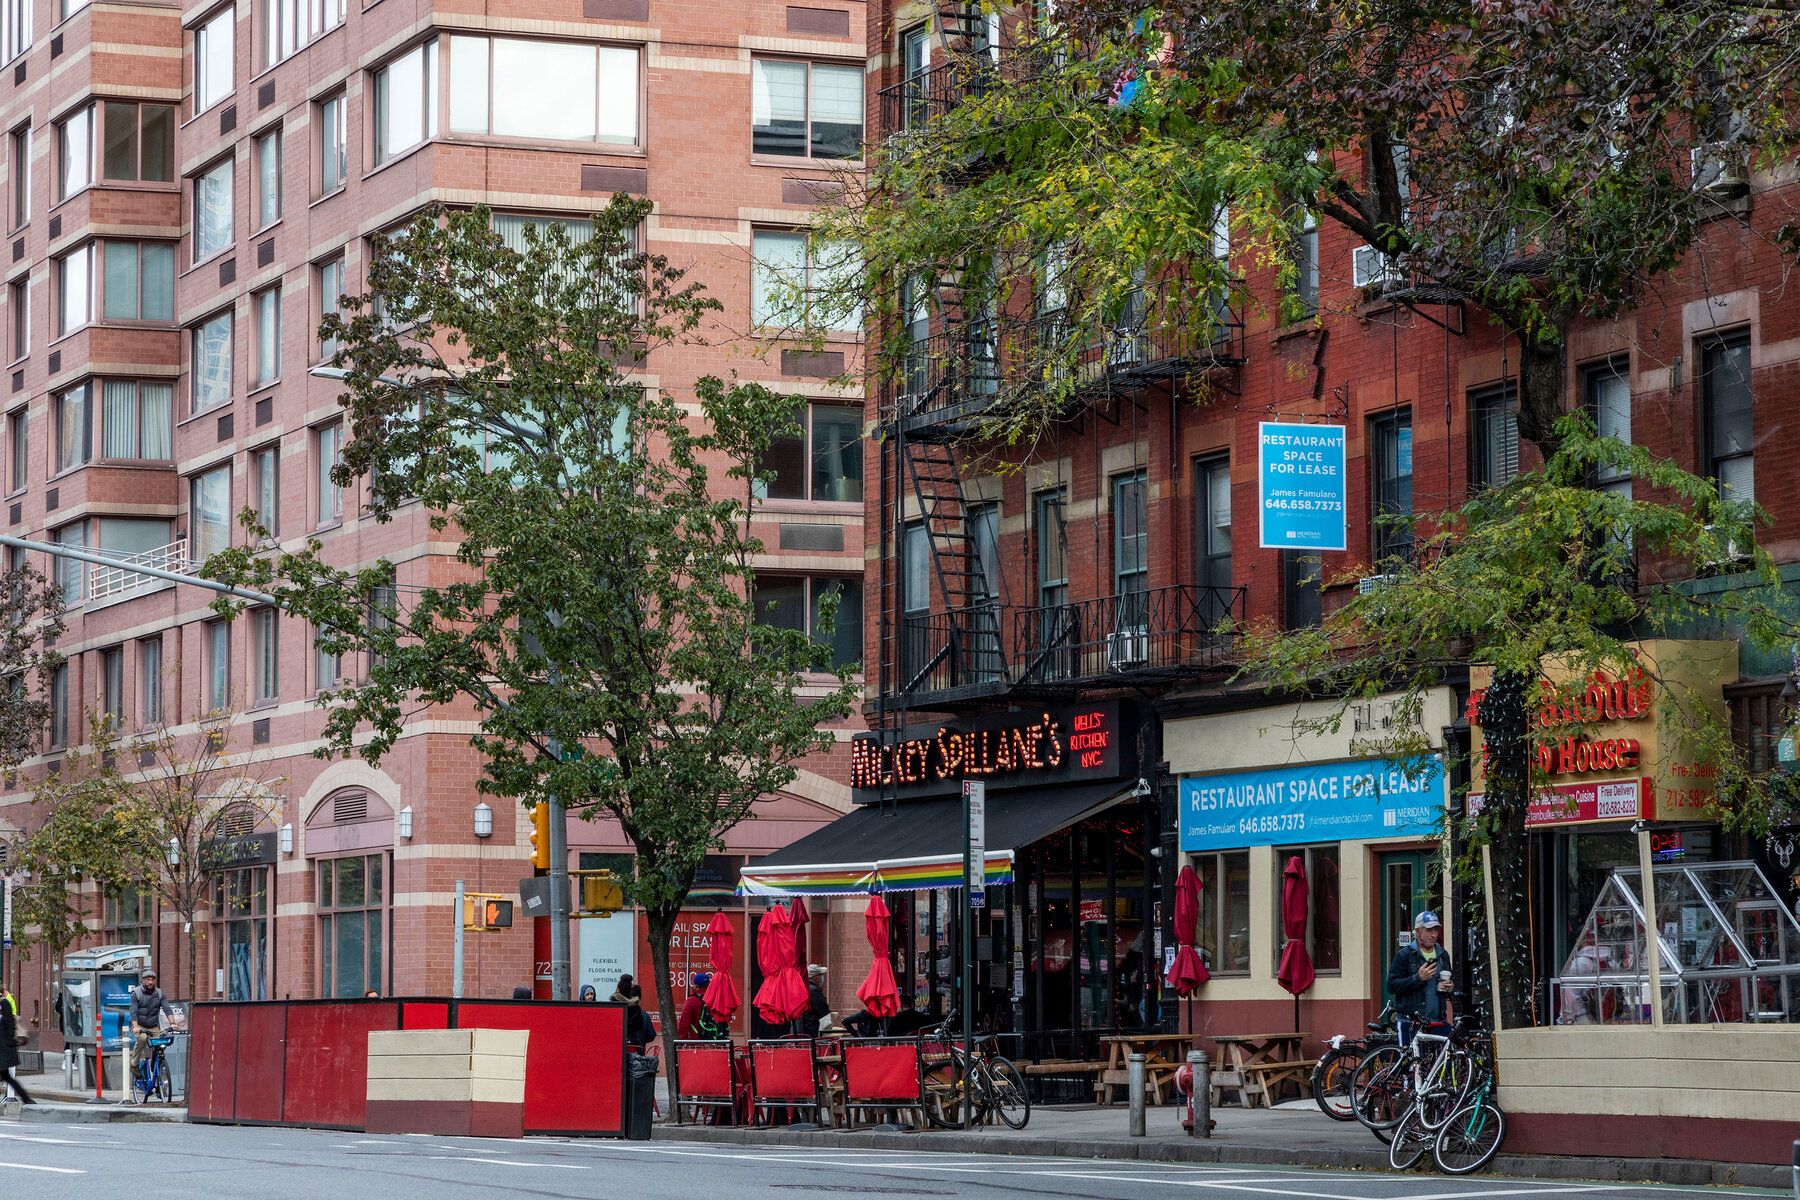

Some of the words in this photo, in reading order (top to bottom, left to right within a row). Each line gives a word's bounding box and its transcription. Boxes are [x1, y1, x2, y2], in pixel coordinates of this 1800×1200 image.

[1263, 434, 1343, 447] RESTAURANT
[1283, 451, 1323, 462] SPACE
[1269, 463, 1295, 474] FOR
[1298, 464, 1336, 475] LEASE
[1270, 488, 1296, 498] James
[1298, 489, 1337, 498] Famularo
[1265, 499, 1342, 511] 646.658.7373
[1070, 731, 1108, 751] KITCHEN
[850, 738, 931, 789] MICKEY
[1081, 750, 1103, 768] NYC
[1557, 736, 1630, 774] House
[1191, 781, 1285, 812] RESTAURANT
[1289, 777, 1337, 803] SPACE
[1343, 774, 1376, 797] FOR
[1575, 788, 1596, 804] Cuisine
[1601, 786, 1613, 798] Free
[1614, 783, 1635, 798] Delivery
[1397, 806, 1430, 818] MERIDIAN
[1598, 800, 1636, 816] 212-582-8282
[1187, 824, 1207, 836] James
[1208, 823, 1236, 835] Famularo
[1239, 813, 1305, 834] 646.658.7373
